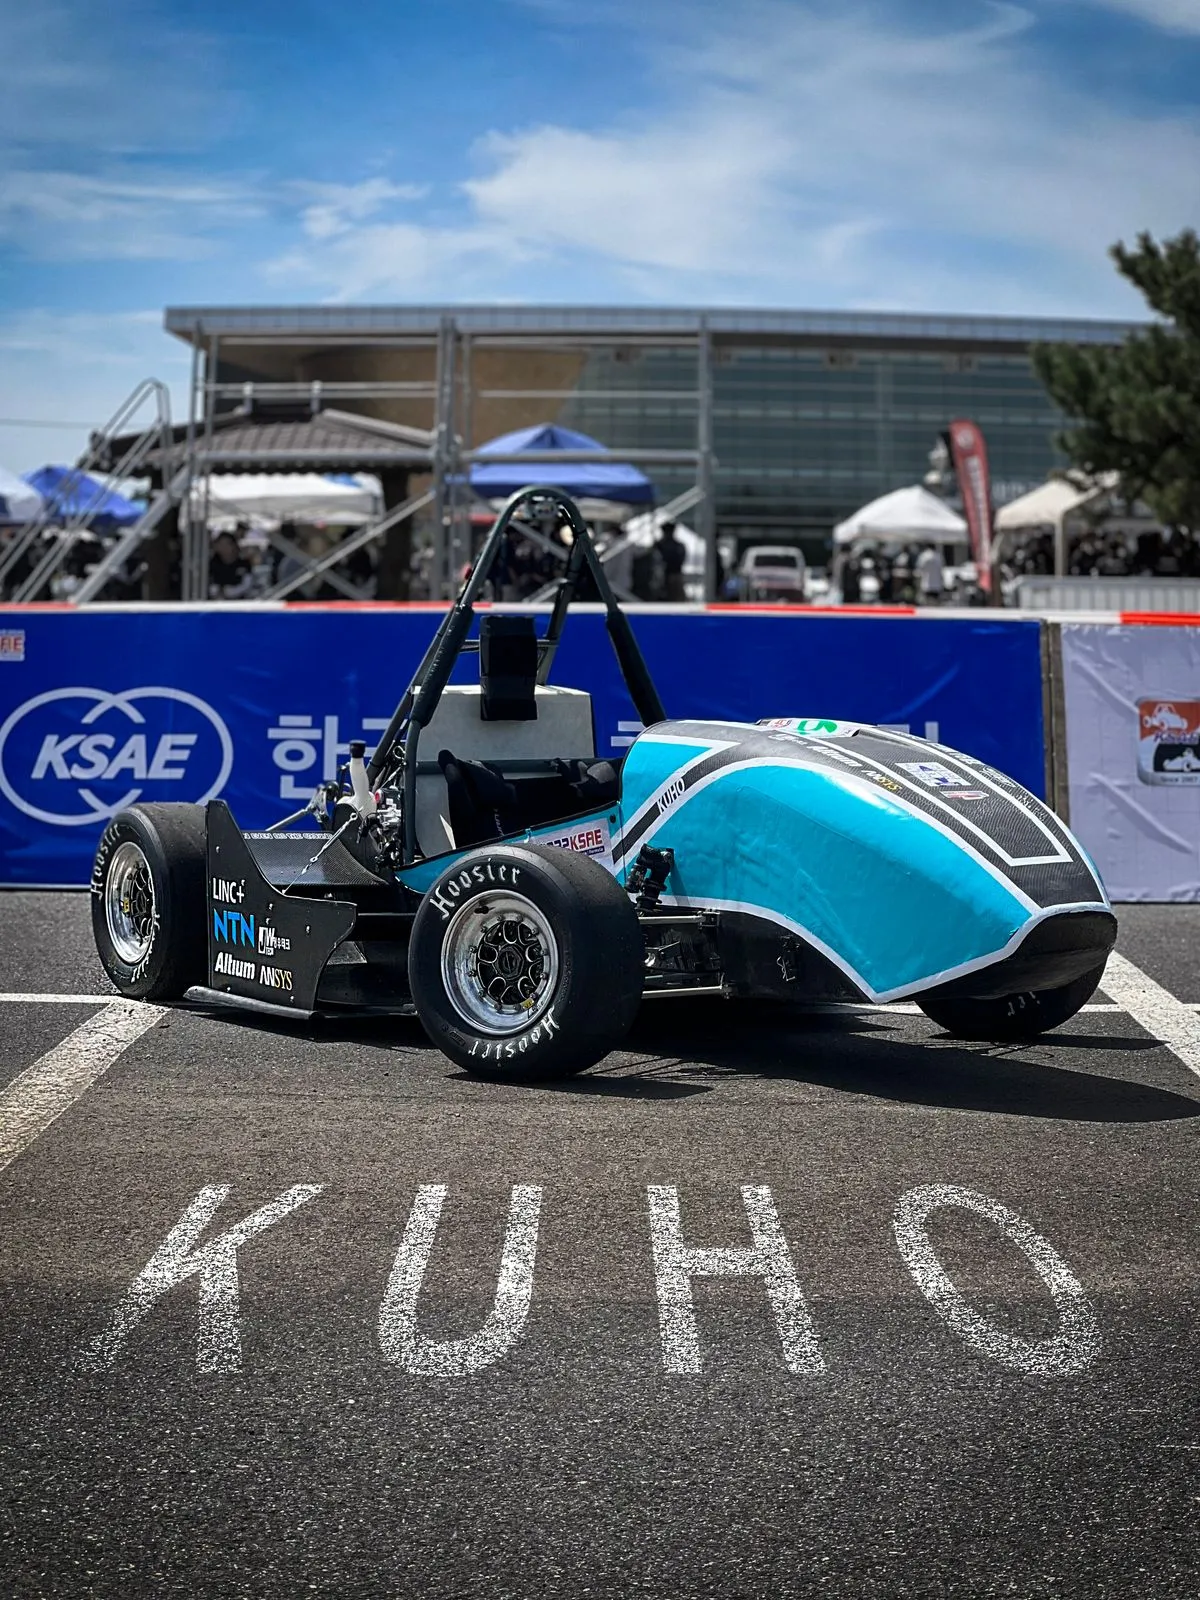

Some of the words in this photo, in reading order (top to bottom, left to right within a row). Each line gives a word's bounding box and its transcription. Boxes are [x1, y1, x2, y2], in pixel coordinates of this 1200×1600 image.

[31, 734, 198, 780] KSAE
[656, 777, 685, 815] KUHO
[213, 877, 245, 903] LINC+
[429, 857, 521, 921] Hoosier
[213, 908, 255, 948] NTN
[214, 951, 256, 980] Altium
[259, 965, 293, 991] ANSYS
[468, 1005, 560, 1060] Hoosier
[74, 1184, 1100, 1377] KUHO
